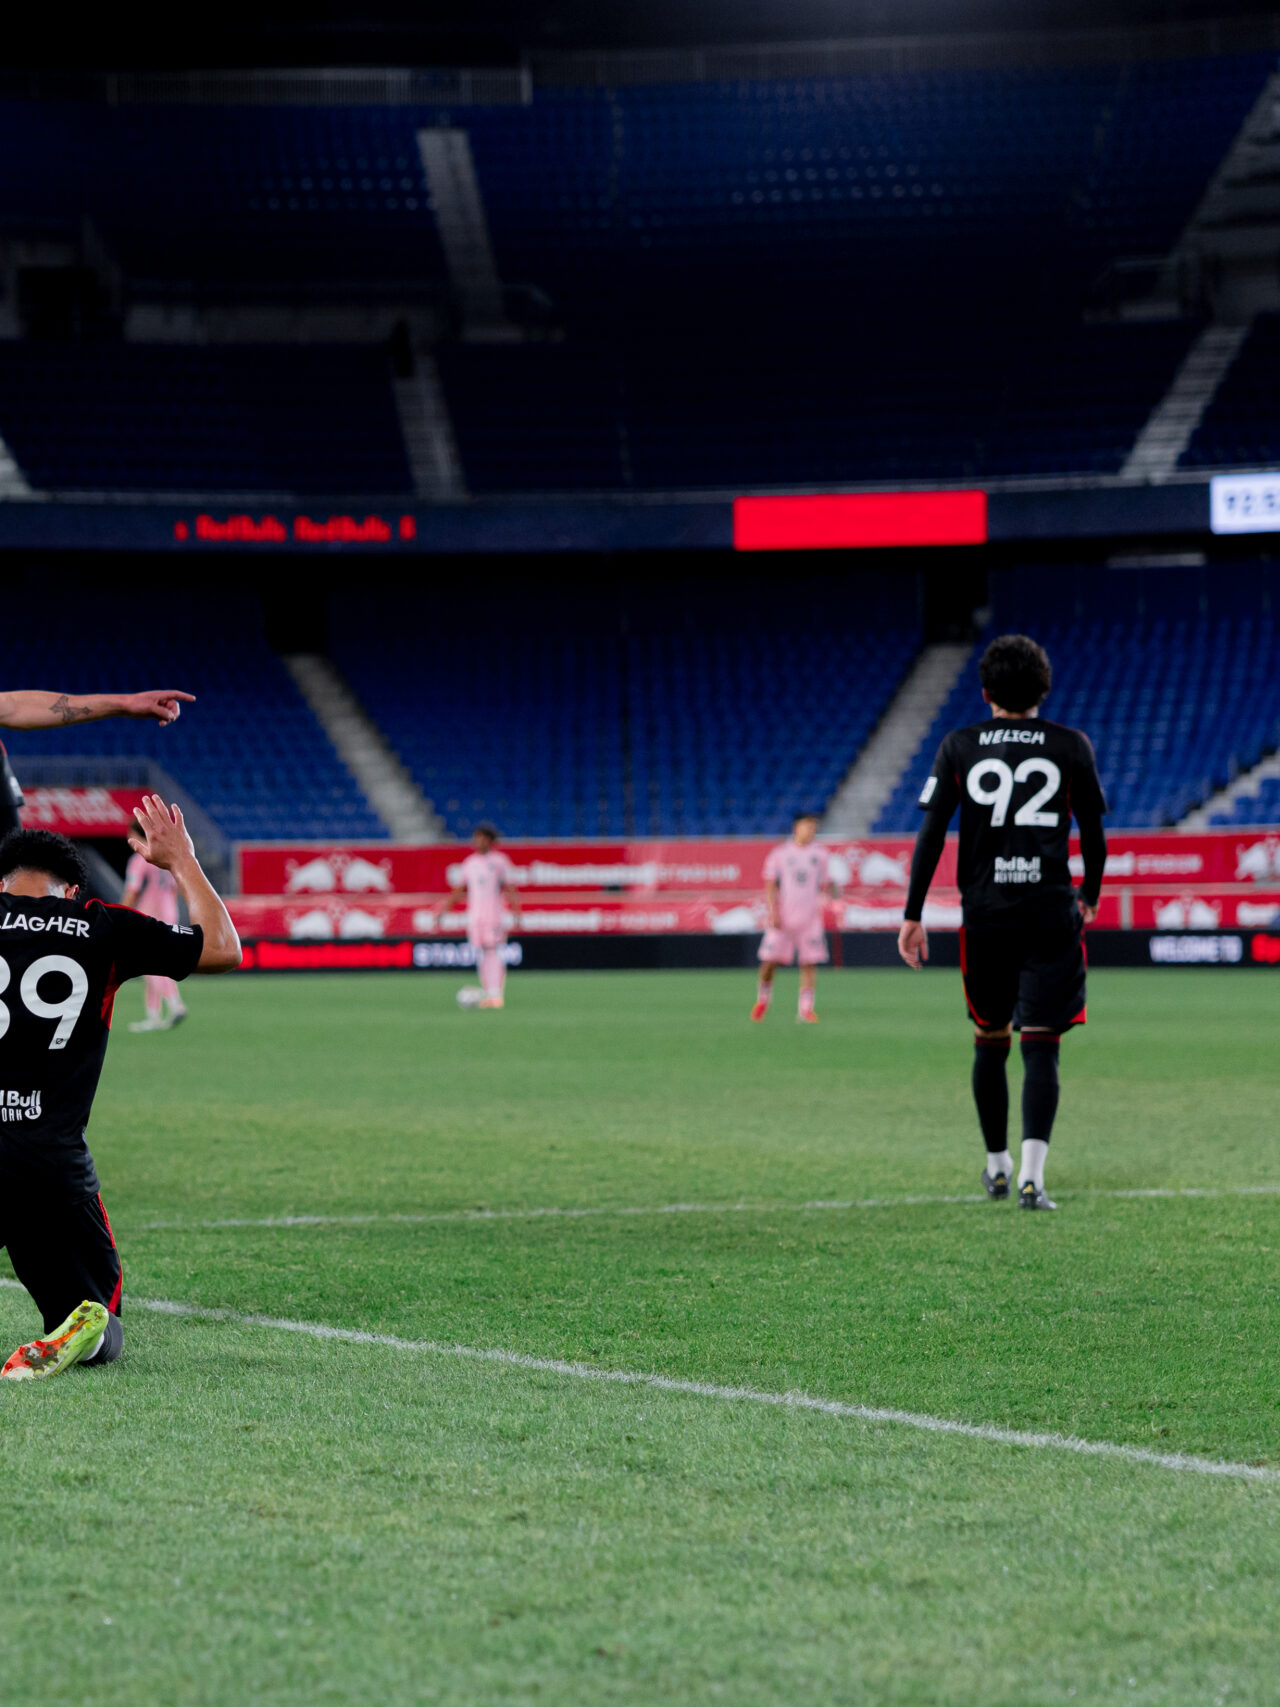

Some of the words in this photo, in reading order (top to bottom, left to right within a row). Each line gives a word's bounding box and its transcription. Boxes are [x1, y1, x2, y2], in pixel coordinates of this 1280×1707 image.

[978, 729, 1046, 746] NELICH
[966, 757, 1062, 828] 92
[6, 1090, 42, 1107] Bull
